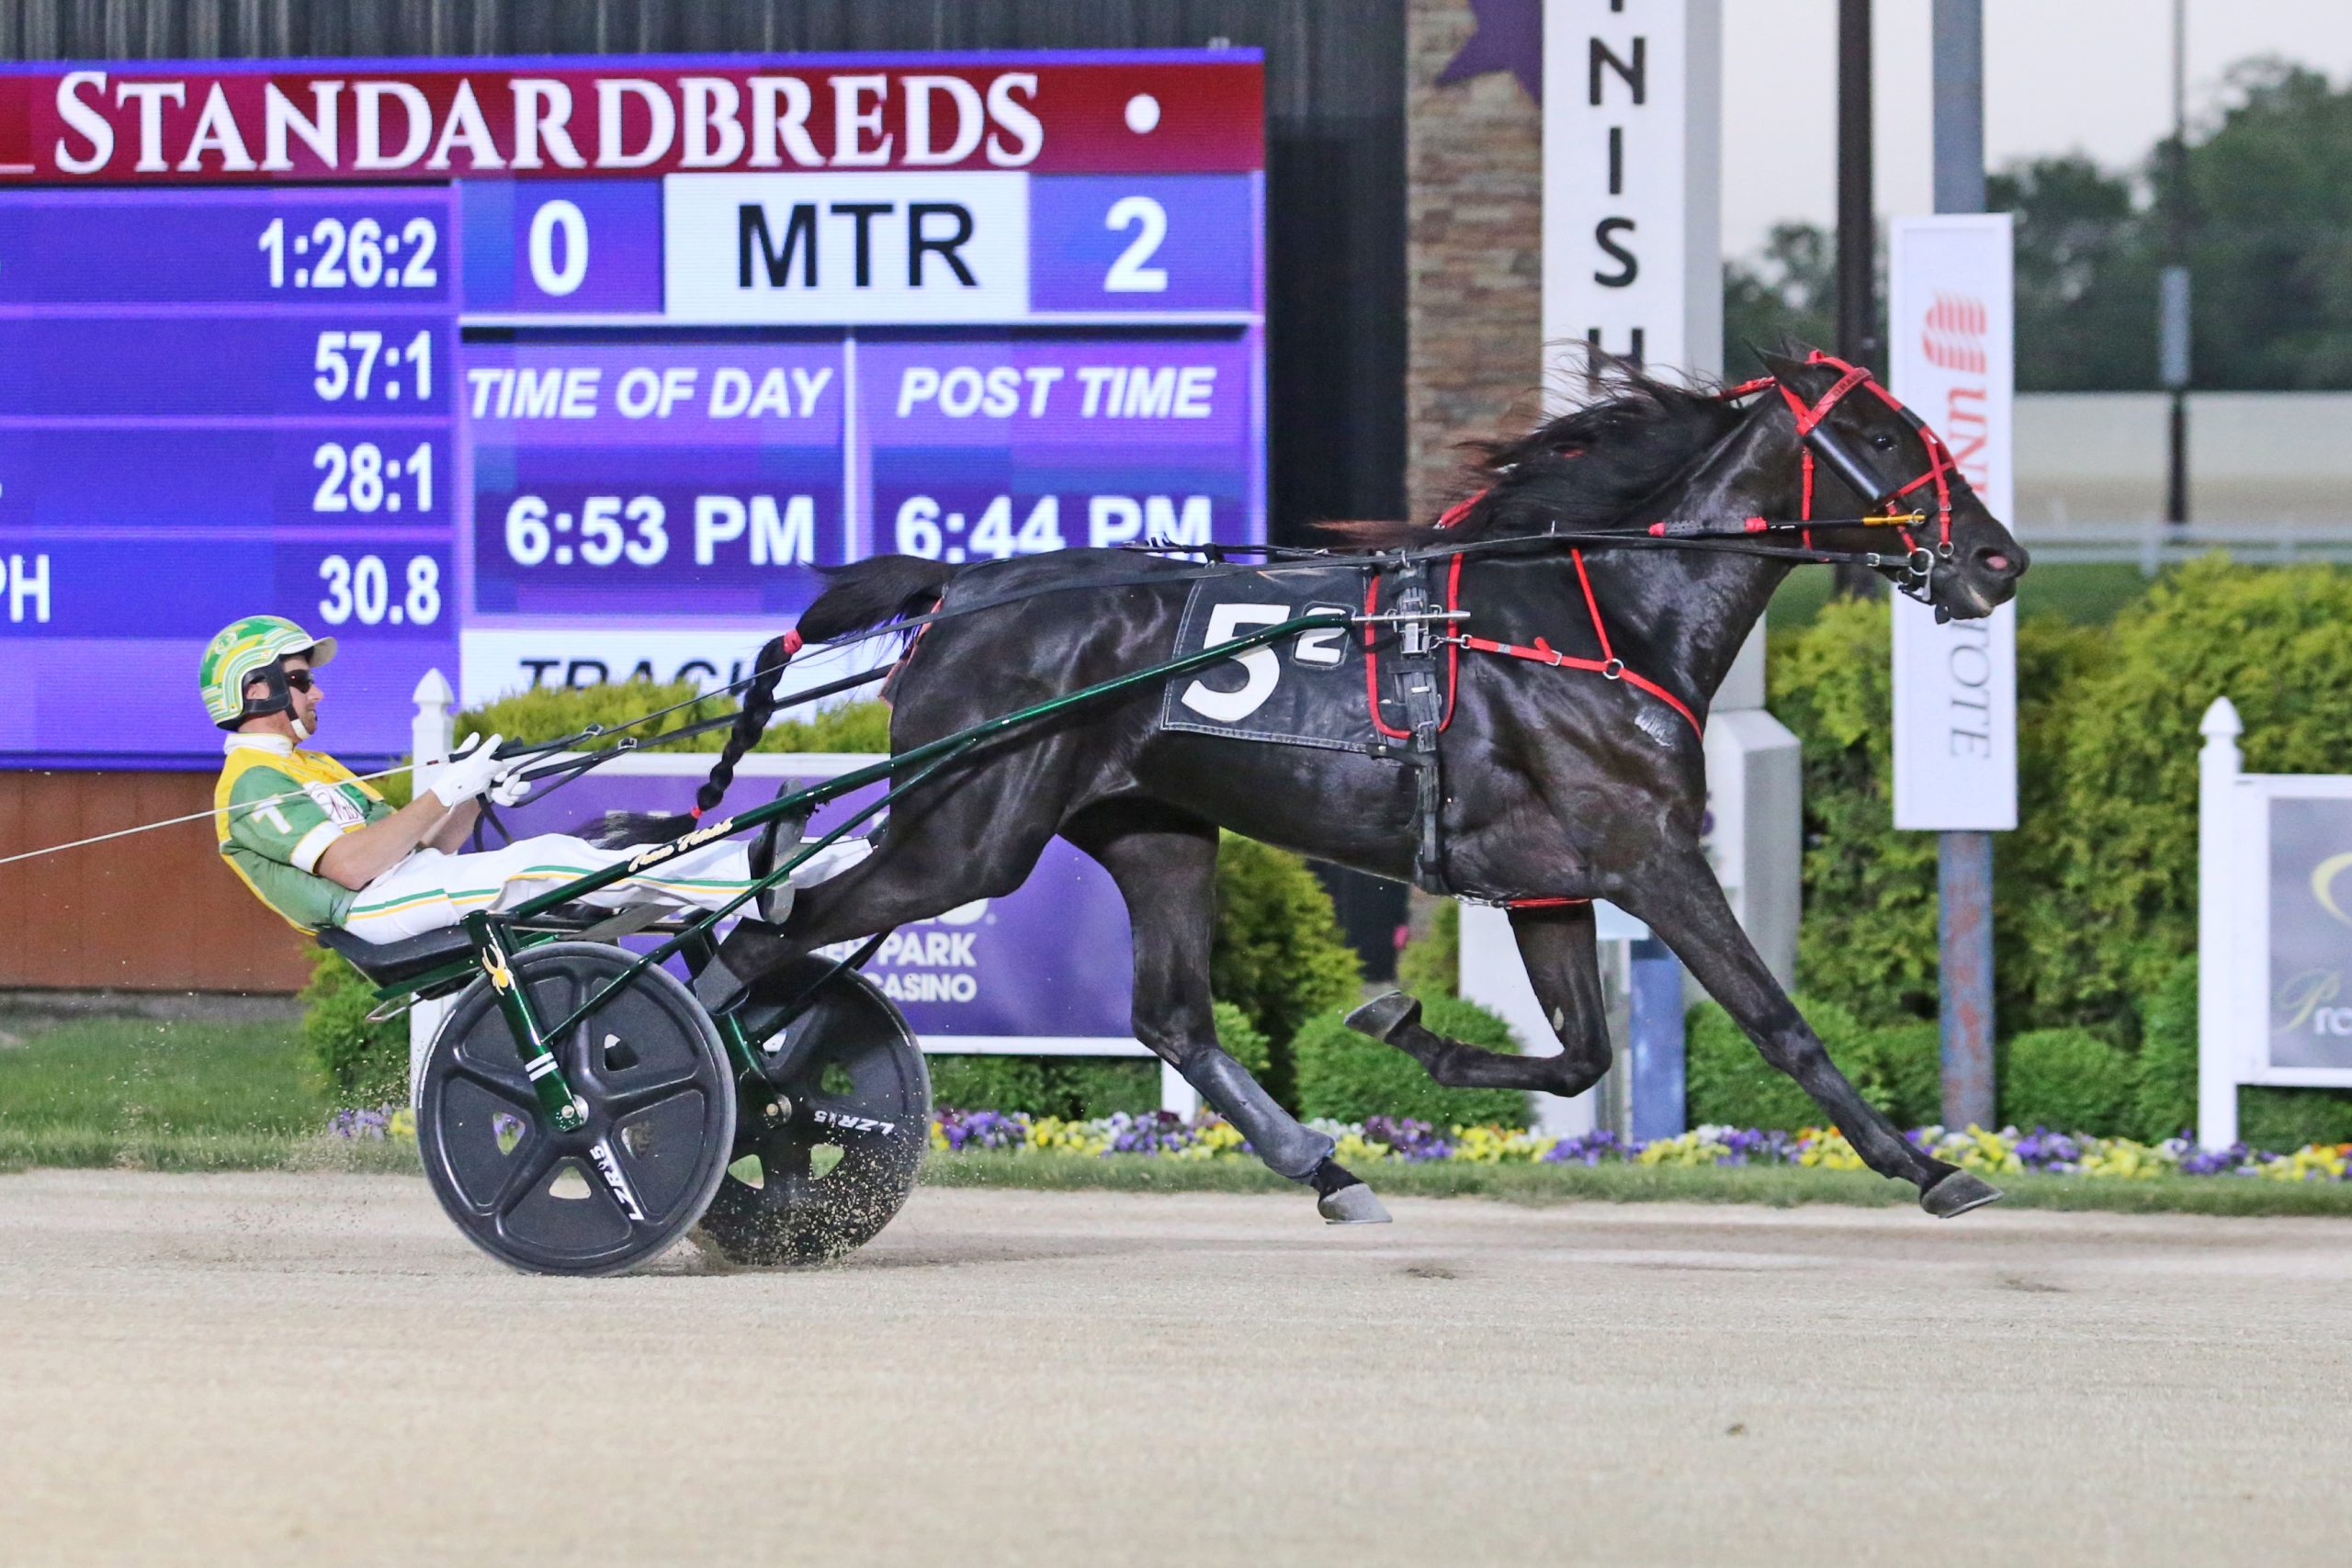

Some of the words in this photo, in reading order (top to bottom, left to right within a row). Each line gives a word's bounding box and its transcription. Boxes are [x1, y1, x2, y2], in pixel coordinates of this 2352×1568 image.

[55, 70, 1044, 174] STANDARDBREDS
[1588, 0, 1645, 397] NISH
[258, 218, 437, 288] 1:26:2
[528, 200, 589, 296] 0
[739, 203, 979, 288] MTR
[1104, 196, 1168, 292] 2
[315, 331, 431, 400] 57:1
[469, 368, 600, 419] TIME
[616, 368, 696, 419] OF
[708, 368, 832, 418] DAY
[897, 367, 1064, 418] POST
[1078, 367, 1216, 418] TIME
[313, 442, 433, 513] 28:1
[505, 496, 670, 566] 6:53
[695, 496, 814, 564] PM
[895, 495, 1068, 564] 6:44
[1089, 495, 1214, 563] PM
[0, 554, 51, 623] H
[319, 554, 441, 626] 30.8
[1181, 604, 1290, 722] 5
[1295, 607, 1347, 663] 2
[877, 932, 977, 966] PARK
